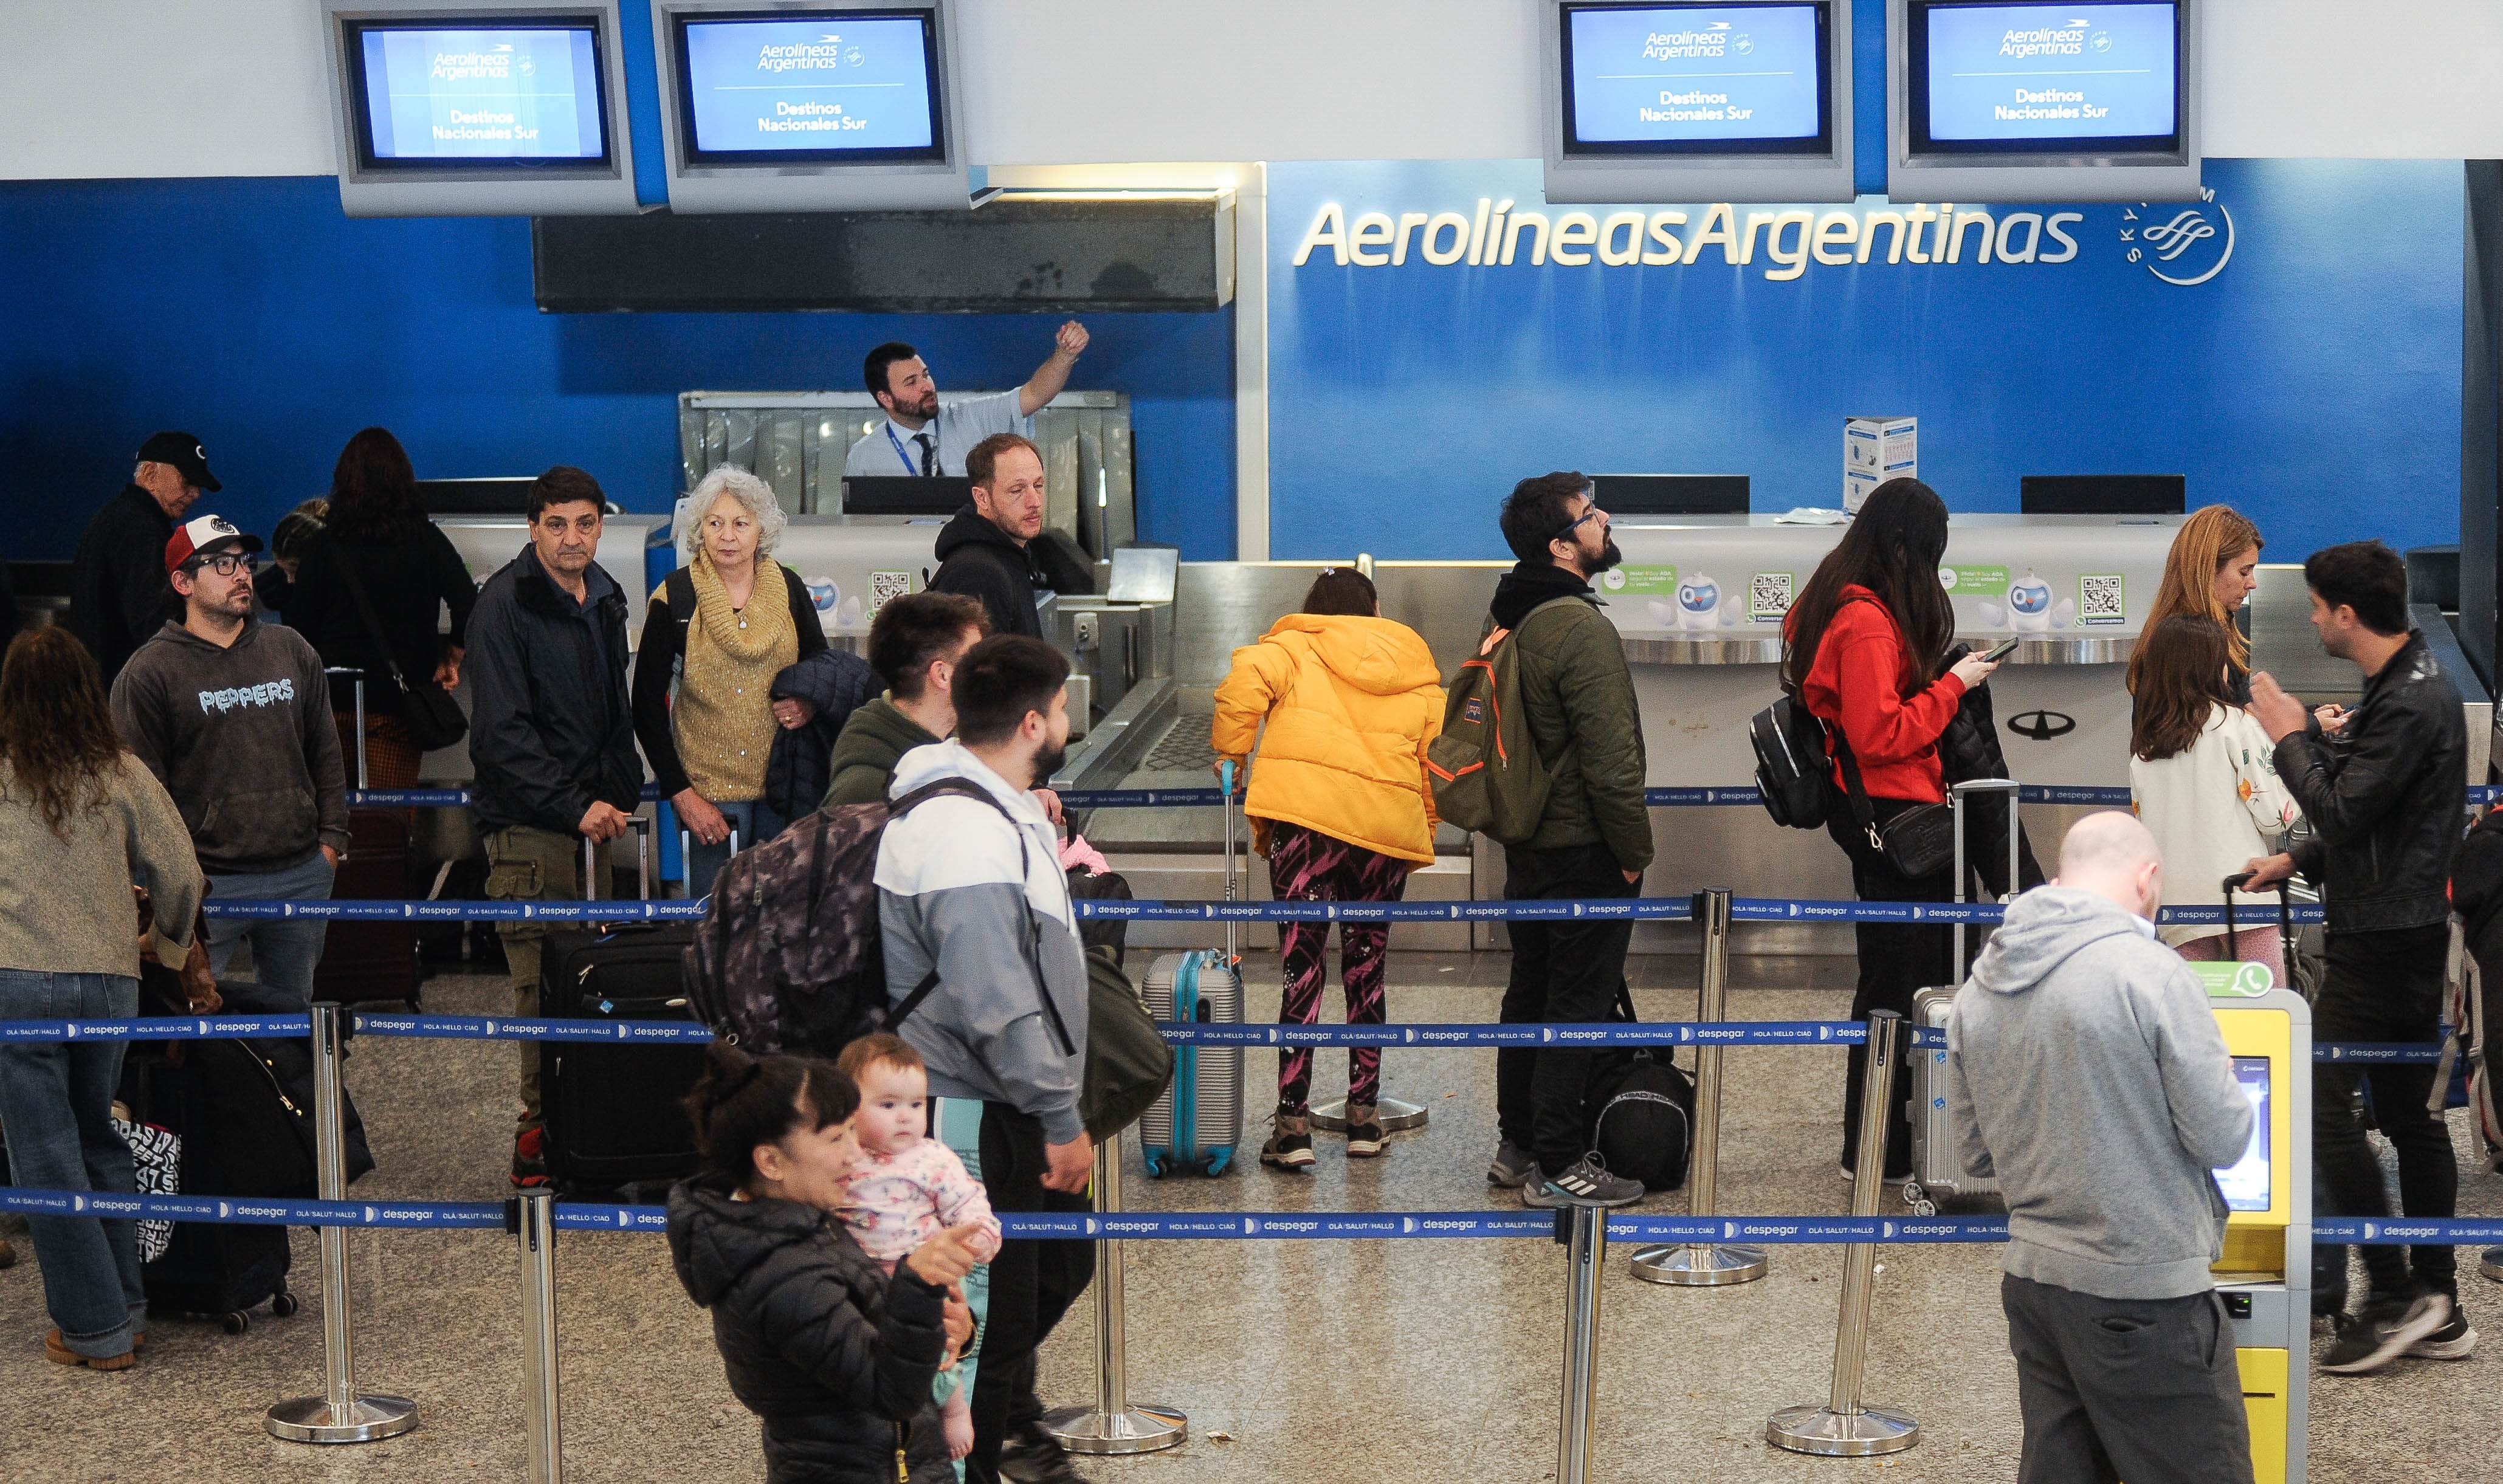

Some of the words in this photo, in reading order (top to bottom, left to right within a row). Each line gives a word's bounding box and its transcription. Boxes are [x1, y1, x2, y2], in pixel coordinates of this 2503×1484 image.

[1645, 30, 1727, 46] Aerolíneas
[2002, 27, 2084, 43] Aerolíneas
[759, 43, 838, 58] Aerolíneas
[1642, 45, 1724, 61] Argentinas
[1999, 42, 2082, 58] Argentinas
[433, 52, 509, 66] Aerolíneas
[757, 57, 837, 73] Argentinas
[431, 64, 509, 81] Argentinas
[1660, 91, 1727, 105] Destinos
[2016, 88, 2084, 103] Destinos
[776, 101, 842, 115] Destinos
[1640, 106, 1724, 122] Nacionales
[1727, 105, 1753, 120] Sur
[1995, 105, 2079, 120] Nacionales
[2082, 104, 2109, 118] Sur
[450, 109, 514, 124] Destinos
[758, 117, 839, 131] Nacionales
[842, 116, 867, 130] Sur
[432, 126, 512, 139] Nacionales
[514, 126, 539, 139] Sur
[198, 678, 294, 715] PEPPERS
[300, 905, 339, 915] despegar
[420, 905, 460, 915] despegar
[540, 907, 580, 915] despegar
[1098, 906, 1139, 915] despegar
[1221, 907, 1262, 916] despegar
[2302, 910, 2324, 919] desp
[84, 1026, 128, 1034] despegar
[216, 1022, 260, 1031] despegar
[371, 1020, 415, 1030] despegar
[503, 1024, 547, 1034] despegar
[635, 1028, 679, 1037] despegar
[1286, 1031, 1332, 1041] despegar
[1422, 1031, 1468, 1040] despegar
[1560, 1030, 1606, 1040] despegar
[1698, 1029, 1744, 1039] despegar
[1836, 1028, 1866, 1037] despe
[93, 1201, 141, 1211] despegar
[238, 1206, 286, 1217] despegar
[384, 1210, 433, 1220] despegar
[1106, 1222, 1159, 1232] despegar
[1264, 1221, 1318, 1231] despegar
[1424, 1220, 1476, 1230] despegar
[1744, 1226, 1798, 1236] despegar
[1903, 1225, 1957, 1235] despegar
[2384, 1227, 2439, 1237] despegar
